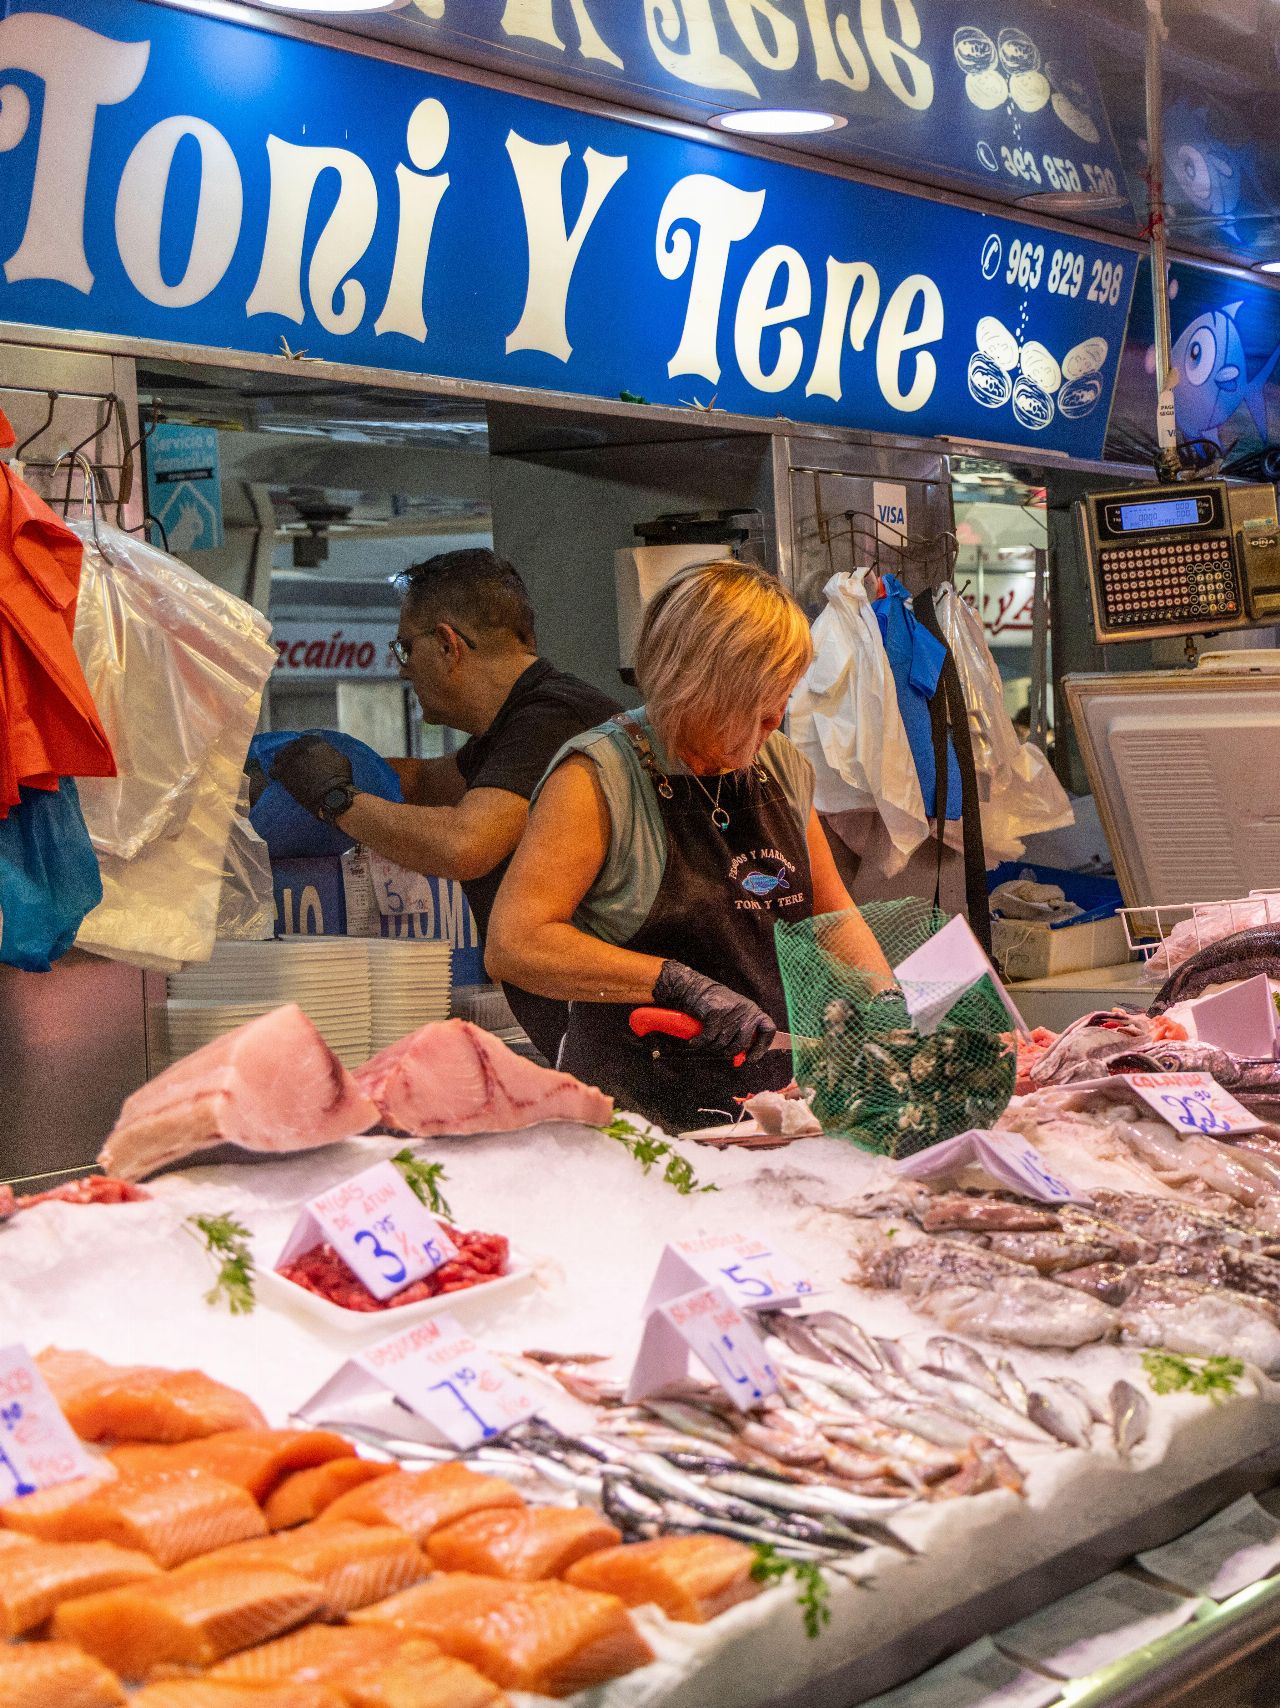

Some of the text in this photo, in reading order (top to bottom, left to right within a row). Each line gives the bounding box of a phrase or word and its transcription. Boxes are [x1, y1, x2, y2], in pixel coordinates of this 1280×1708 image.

[0, 13, 450, 343] Toni
[656, 174, 944, 412] Tere
[1006, 239, 1123, 305] 963 829 298
[876, 505, 905, 525] VISA
[778, 892, 804, 907] TERE
